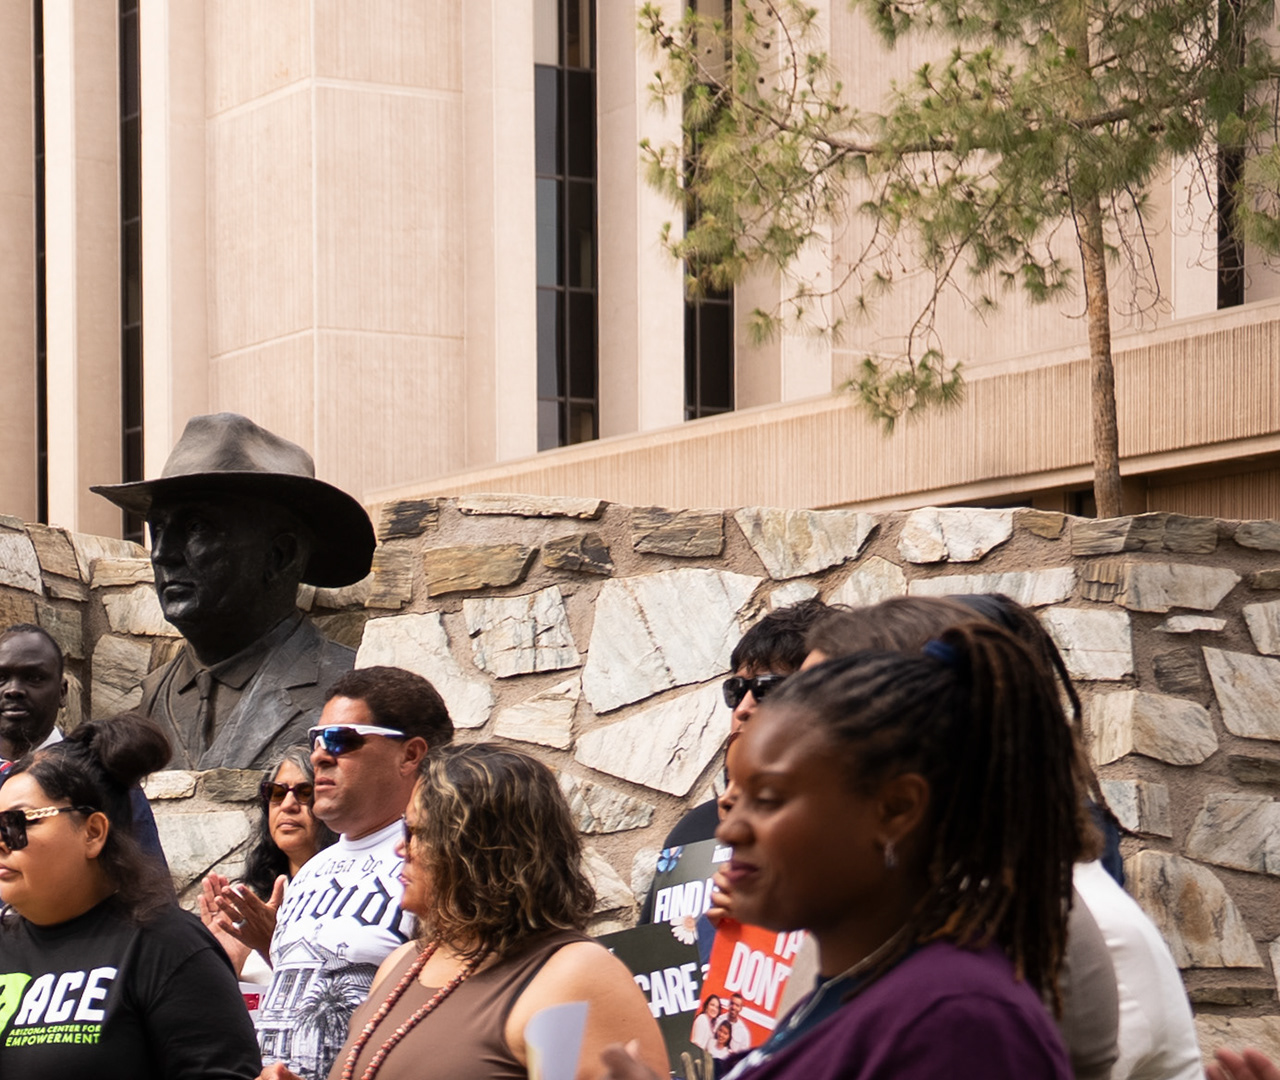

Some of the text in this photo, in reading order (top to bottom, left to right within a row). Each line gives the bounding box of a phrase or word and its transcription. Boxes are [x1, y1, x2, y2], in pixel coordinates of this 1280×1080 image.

[13, 966, 118, 1026] ACE
[8, 1024, 101, 1036] ARIZONA CENTER FOR
[5, 1032, 100, 1047] EMPOWERMENT
